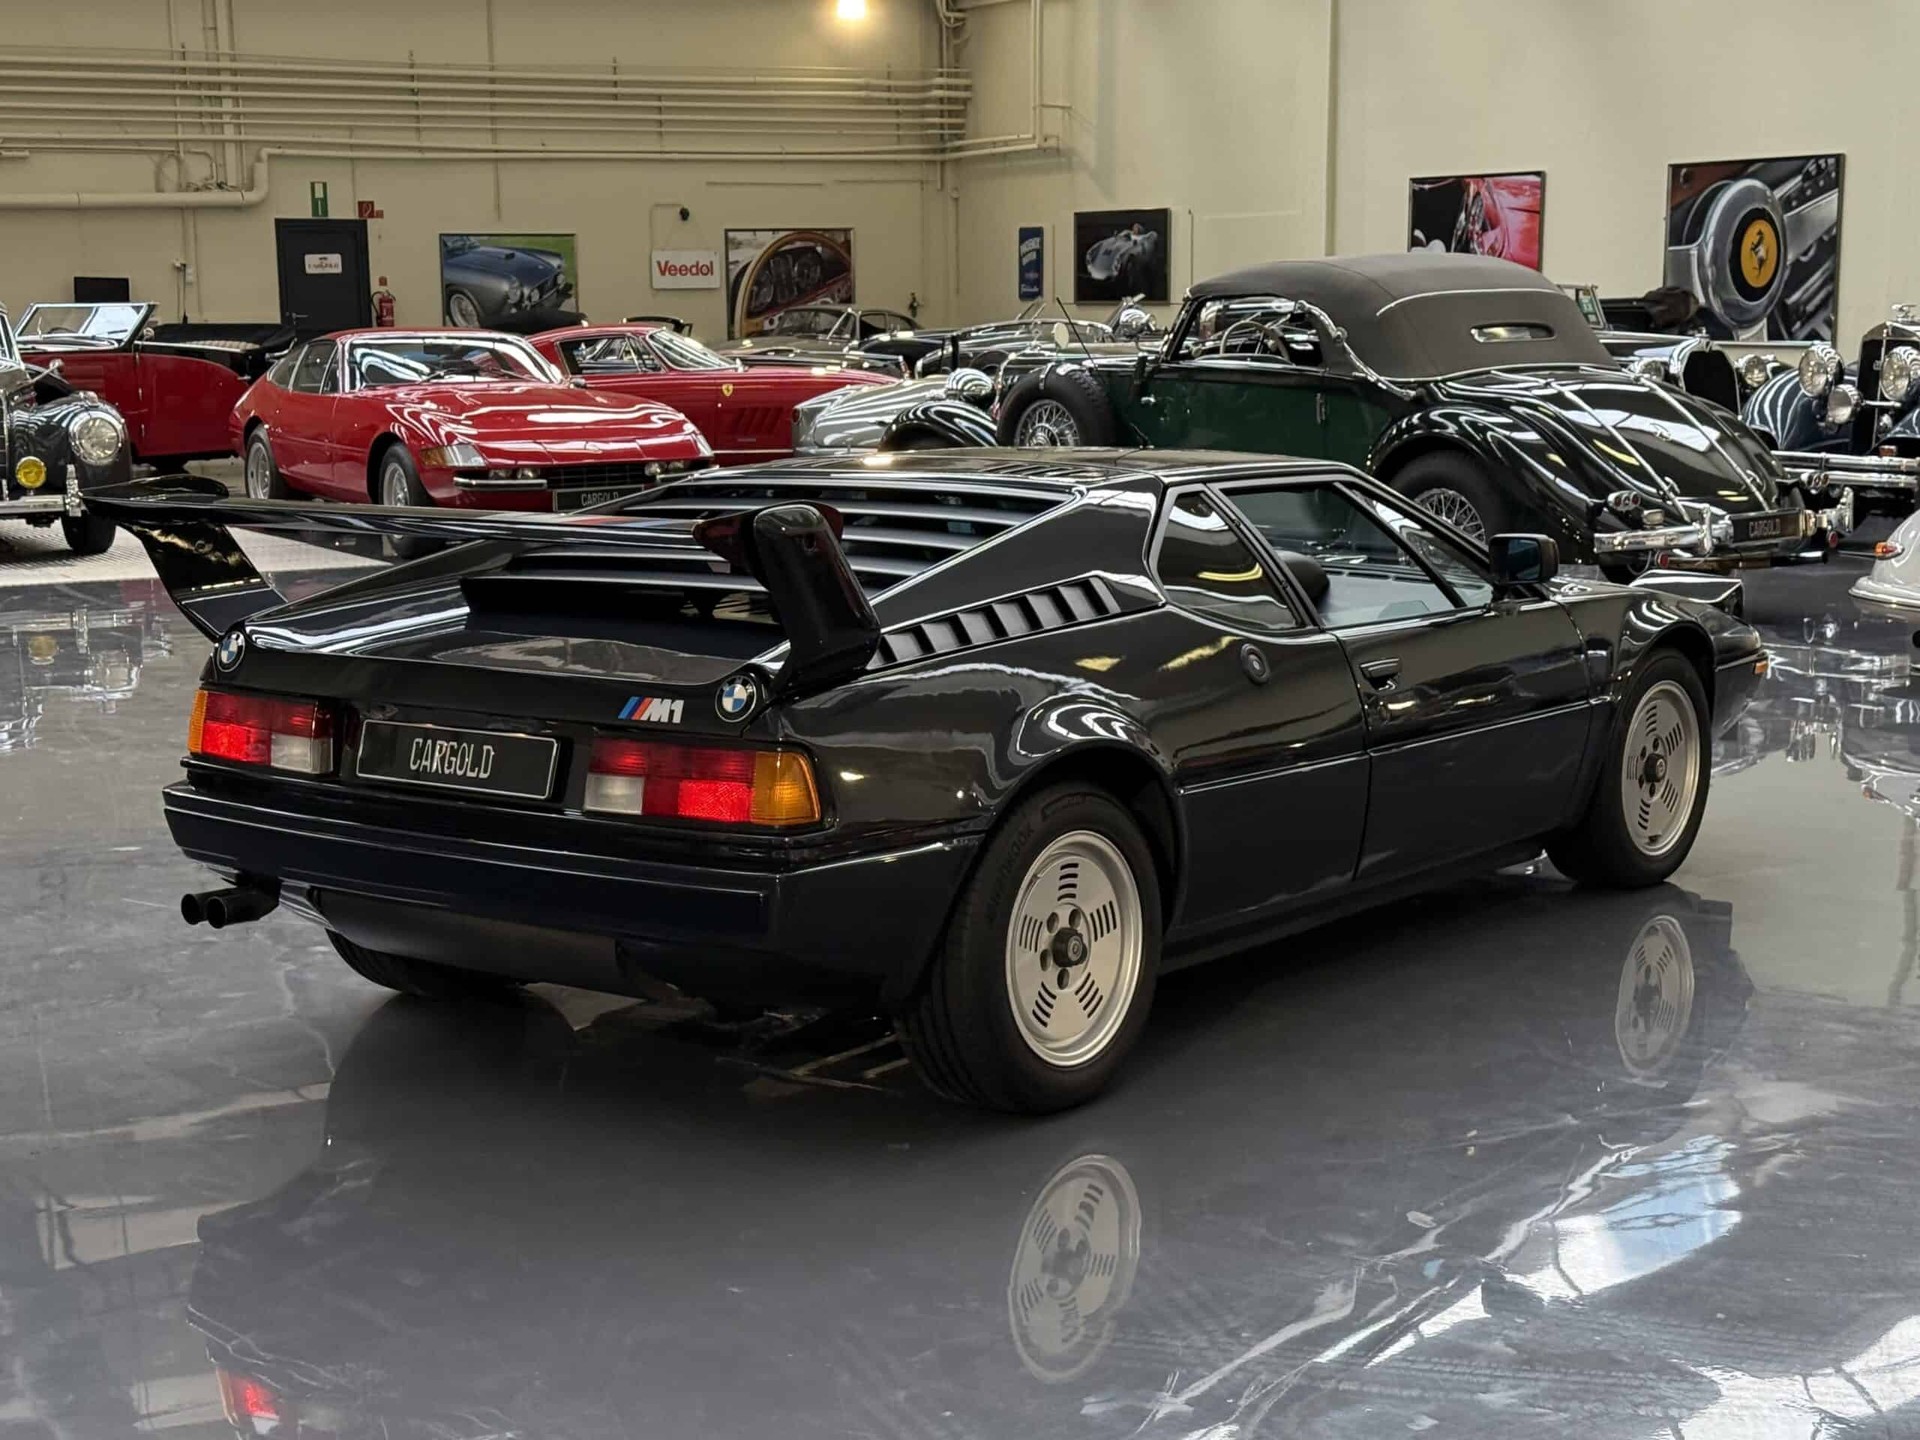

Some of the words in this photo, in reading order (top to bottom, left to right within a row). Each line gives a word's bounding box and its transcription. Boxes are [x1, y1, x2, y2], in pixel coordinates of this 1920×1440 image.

[656, 260, 714, 276] Veedol
[640, 697, 685, 724] M1
[410, 738, 495, 779] CARGOLD
